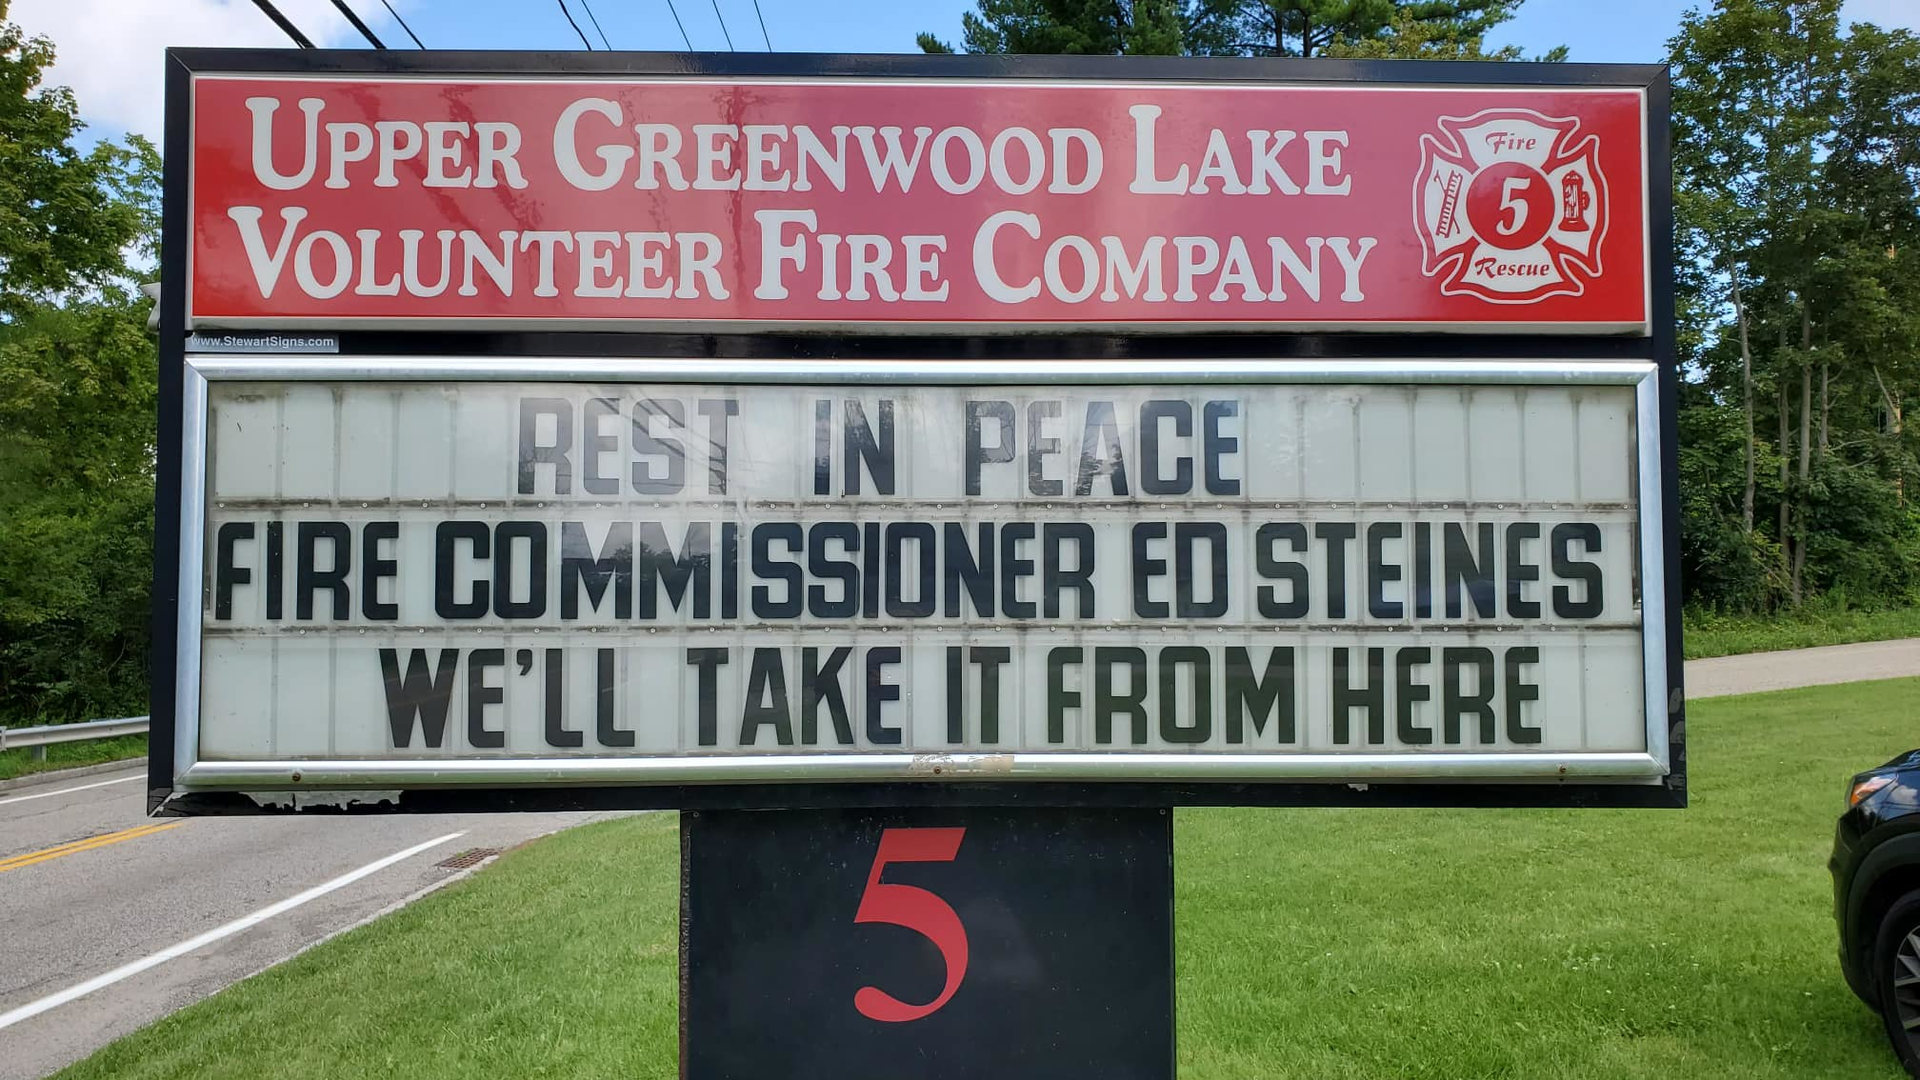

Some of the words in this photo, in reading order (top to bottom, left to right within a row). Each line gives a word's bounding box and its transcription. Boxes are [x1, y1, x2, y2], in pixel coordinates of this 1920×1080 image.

[245, 97, 528, 190] UPPER
[552, 97, 1103, 196] GREENWOOD
[1129, 104, 1352, 196] LAKE
[1485, 132, 1537, 154] Fire
[228, 206, 729, 299] VOLUNTEER
[754, 209, 949, 301] FIRE
[972, 210, 1378, 304] COMPANY
[1496, 177, 1531, 236] 5
[1474, 257, 1550, 279] Rescue
[191, 335, 334, 348] www.StewartSigns.com
[517, 397, 739, 495] REST
[814, 399, 896, 495] IN
[965, 400, 1241, 496] PEACE
[215, 521, 400, 621] FIRE
[435, 521, 1096, 619] COMMISSIONER
[1132, 522, 1228, 618] ED
[1256, 522, 1604, 619] STEINES
[687, 647, 903, 747] TAKE
[946, 646, 1011, 744] IT
[1047, 646, 1295, 744] FROM
[1332, 646, 1542, 744] HERE
[853, 827, 969, 1022] 5
